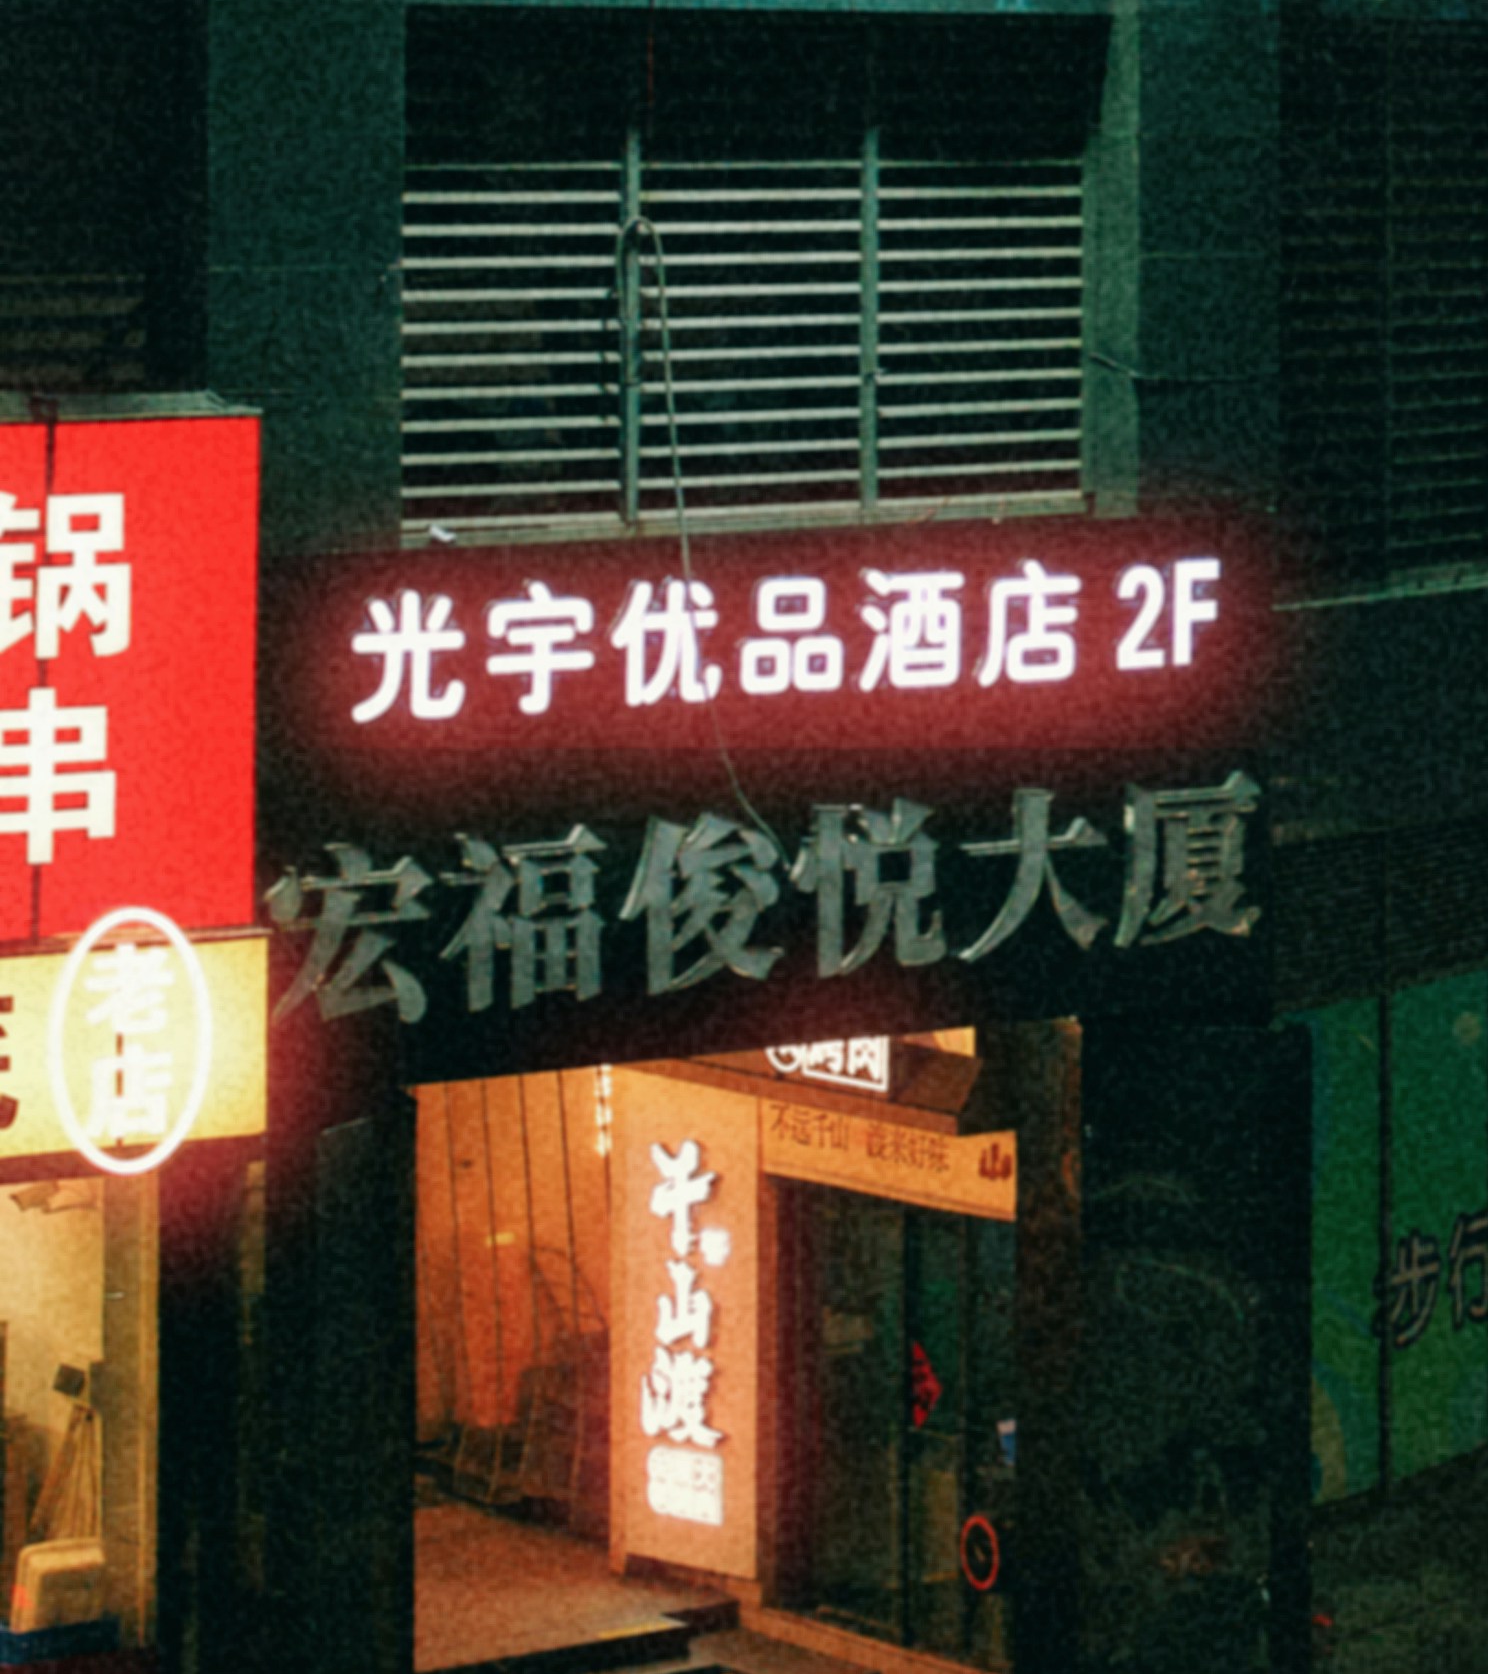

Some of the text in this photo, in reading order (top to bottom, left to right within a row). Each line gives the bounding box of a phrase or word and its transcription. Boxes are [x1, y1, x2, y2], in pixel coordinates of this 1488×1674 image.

[350, 557, 1222, 725] 光宇优品酒店 2F
[265, 770, 1262, 1026] 宏福俊悦大厦
[83, 943, 176, 1140] 老店
